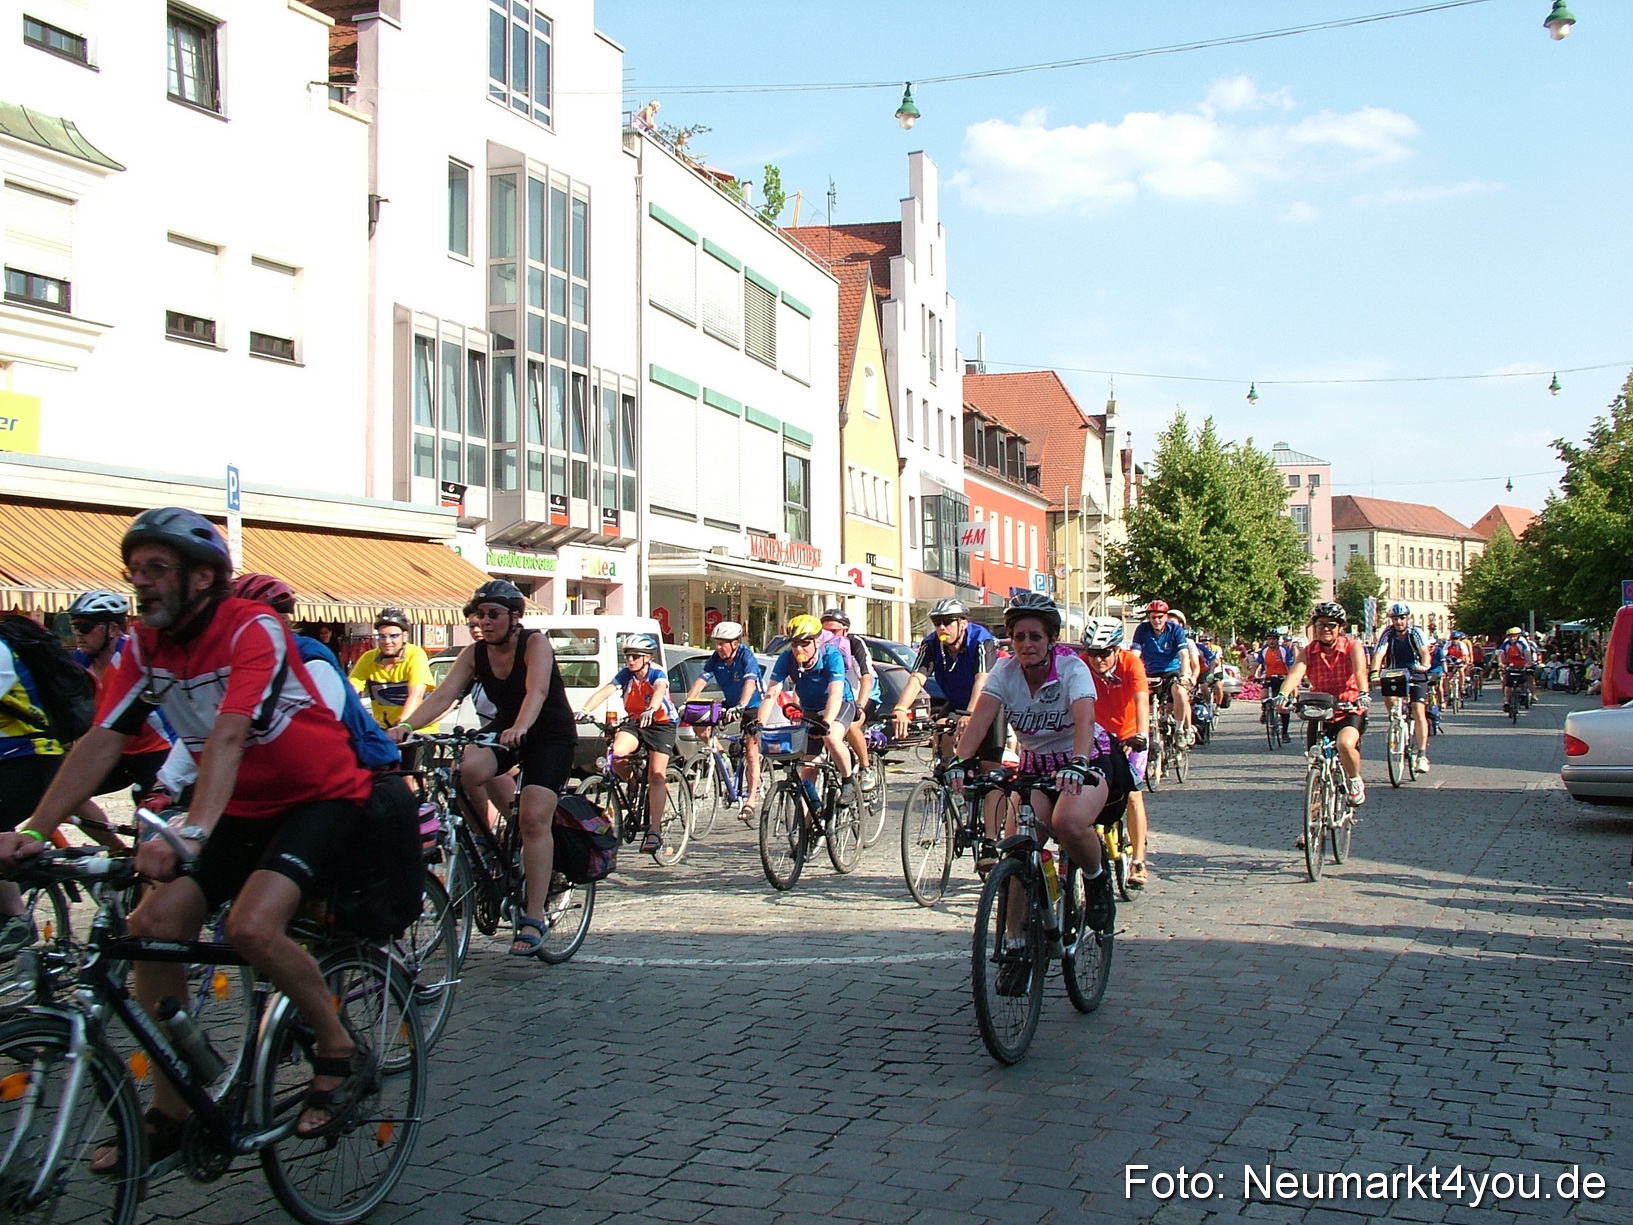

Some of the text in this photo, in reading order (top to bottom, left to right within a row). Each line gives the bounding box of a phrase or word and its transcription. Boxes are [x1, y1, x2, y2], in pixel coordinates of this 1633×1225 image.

[228, 470, 238, 505] P
[960, 527, 986, 547] H&M
[749, 534, 823, 568] MARIEN-APOTHEKE
[1036, 575, 1045, 590] P
